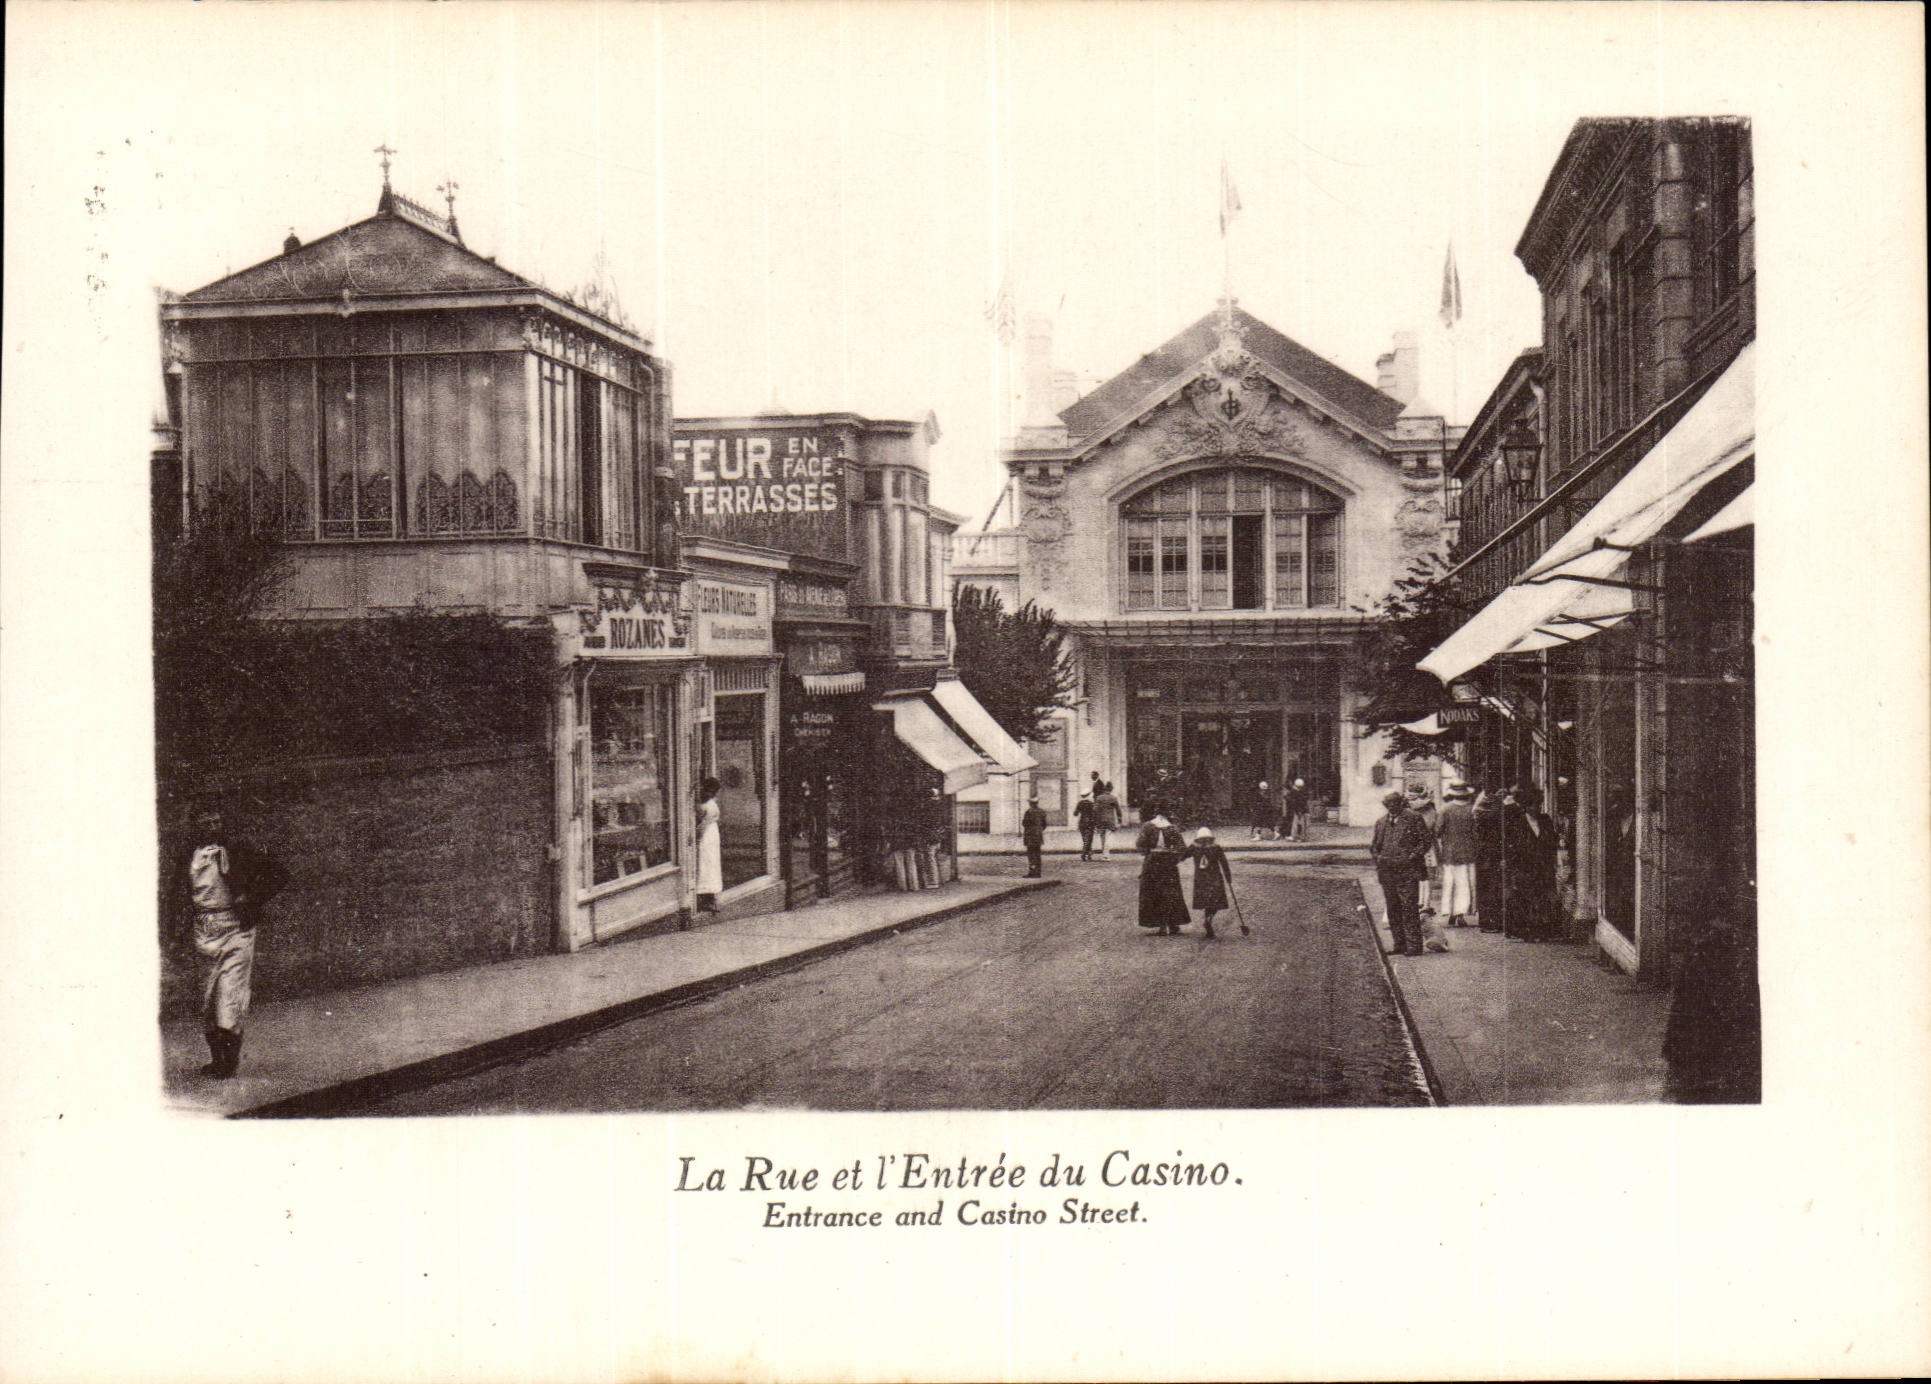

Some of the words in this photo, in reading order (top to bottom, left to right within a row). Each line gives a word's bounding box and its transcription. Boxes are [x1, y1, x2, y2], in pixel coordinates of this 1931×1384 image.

[788, 437, 818, 454] EN
[782, 457, 833, 478] FACE
[683, 482, 838, 515] TERRASSES
[1440, 709, 1479, 724] KODAKS
